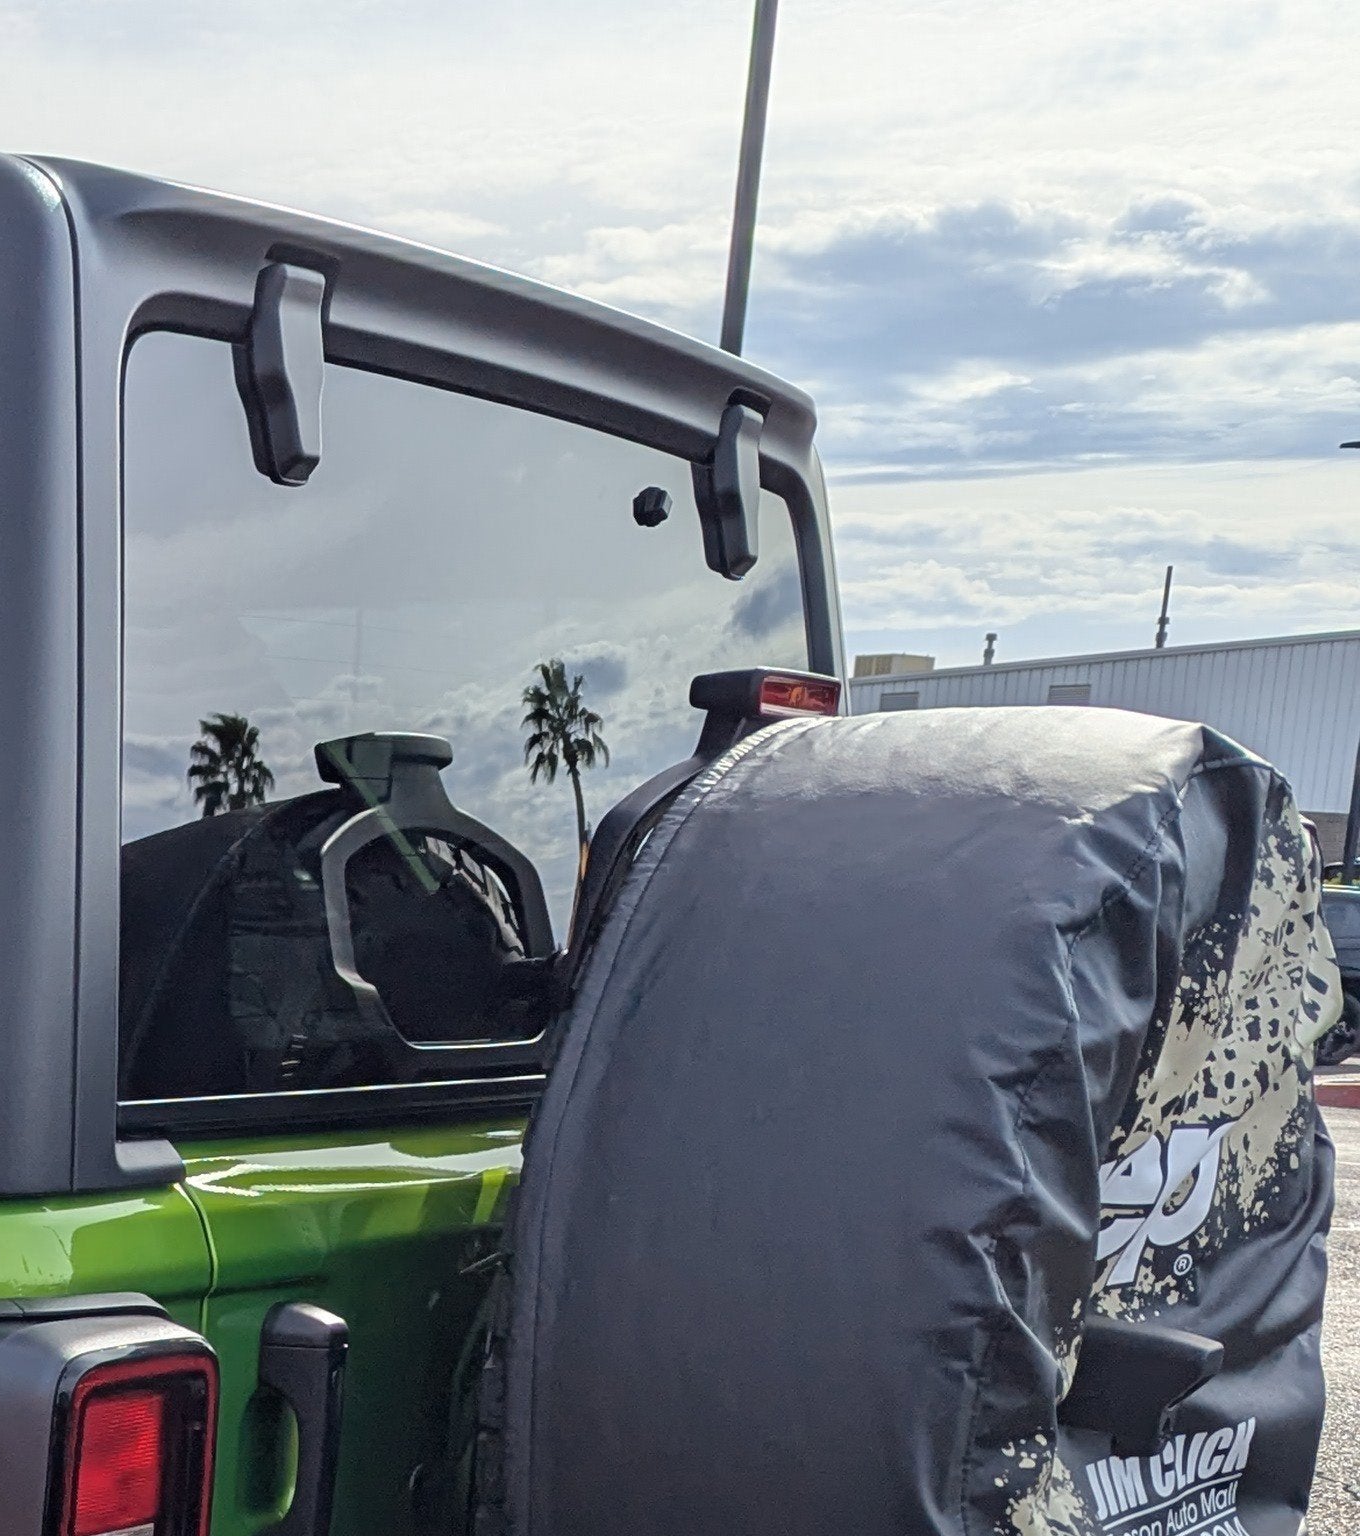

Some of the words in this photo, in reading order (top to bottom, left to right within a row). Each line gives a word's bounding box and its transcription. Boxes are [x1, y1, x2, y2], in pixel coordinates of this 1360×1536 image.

[1086, 1455, 1148, 1521] JIM
[1149, 1417, 1256, 1497] CLICK
[1166, 1501, 1198, 1536] Auto
[1200, 1481, 1238, 1516] Mall
